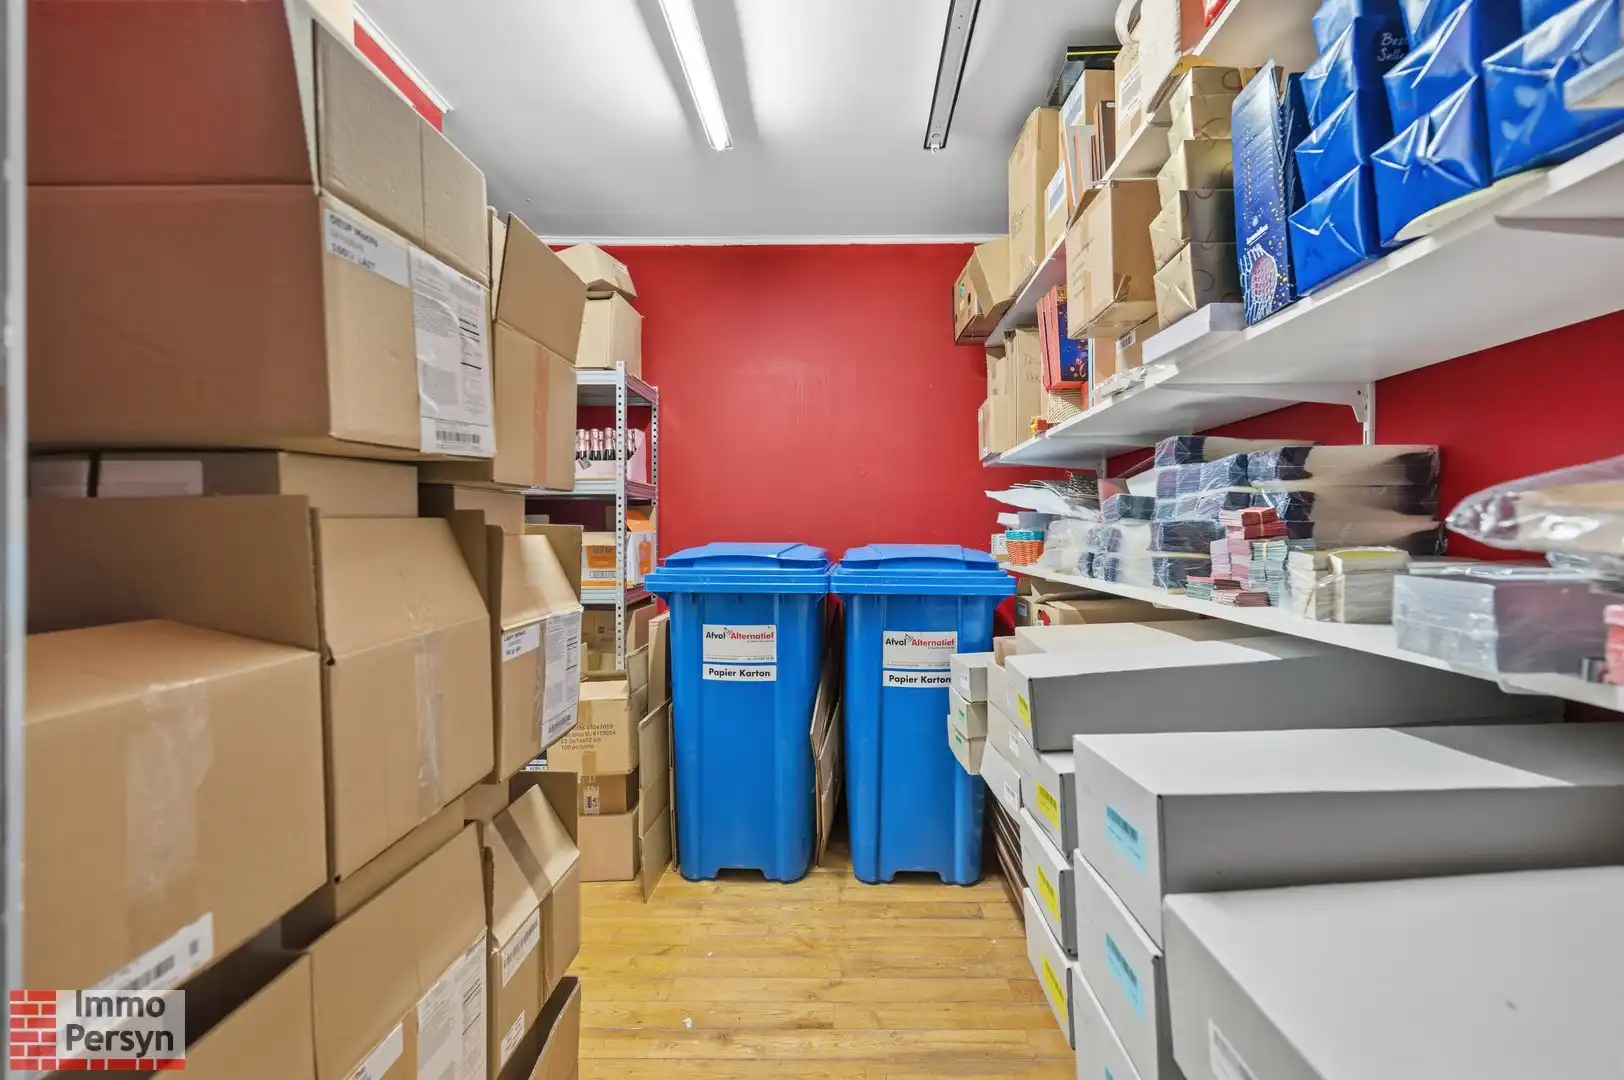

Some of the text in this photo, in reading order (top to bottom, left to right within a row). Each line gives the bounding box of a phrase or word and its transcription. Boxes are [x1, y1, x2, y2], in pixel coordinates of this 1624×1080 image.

[705, 631, 775, 640] Afval Alternatief
[885, 638, 956, 647] Afval Alternatief
[708, 668, 771, 678] Papier Karton
[888, 675, 918, 684] Papier
